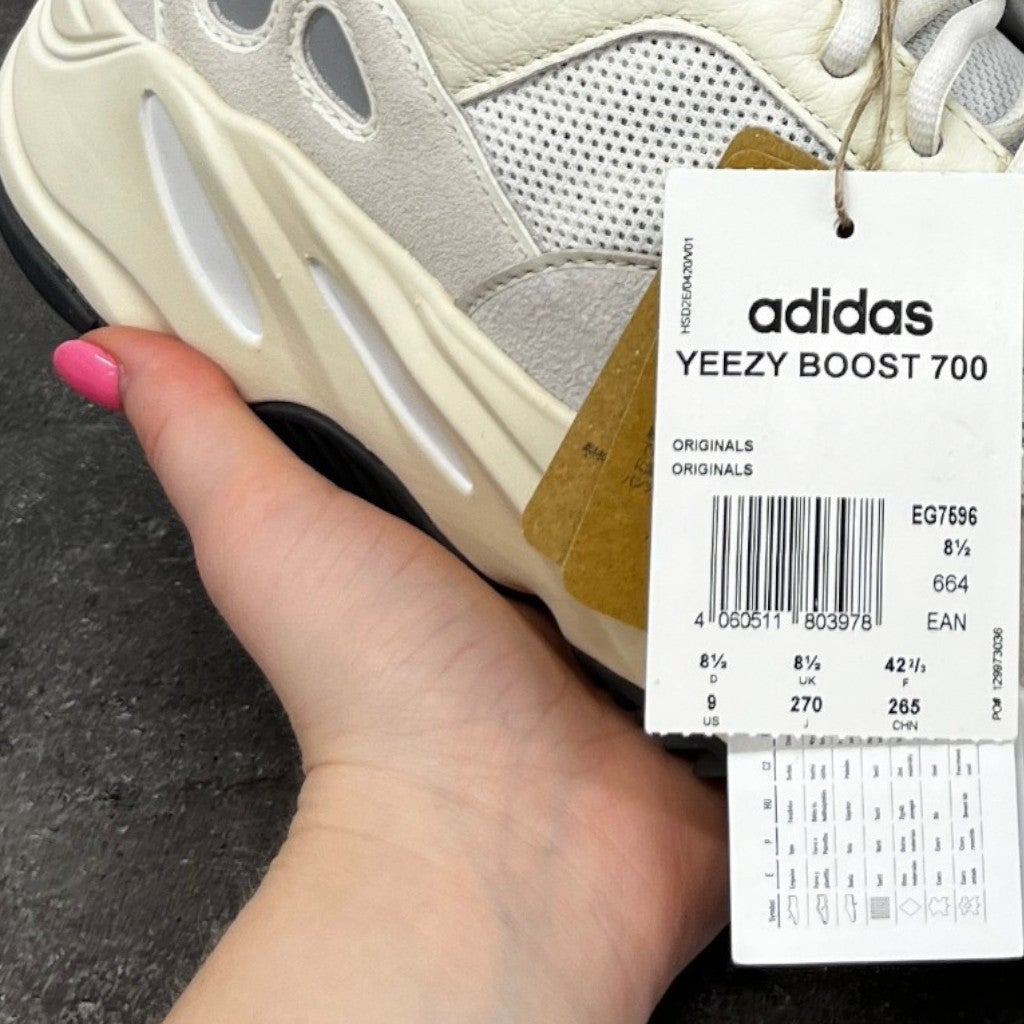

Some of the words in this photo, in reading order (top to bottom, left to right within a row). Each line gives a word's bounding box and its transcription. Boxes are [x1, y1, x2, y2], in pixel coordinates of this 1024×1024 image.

[748, 287, 934, 337] adidas
[676, 350, 788, 377] YEEZY
[799, 351, 921, 380] BOOST
[930, 354, 988, 381] 700
[672, 438, 754, 452] ORIGINALS
[672, 462, 754, 477] ORIGINALS
[912, 504, 978, 526] EG7596
[933, 574, 969, 593] 664
[693, 611, 705, 629] 4
[718, 611, 781, 629] 060511
[804, 612, 873, 632] 803978
[927, 611, 967, 632] EAN
[884, 656, 906, 673] 42
[709, 673, 718, 685] D
[799, 675, 816, 686] UK
[902, 677, 909, 688] F
[707, 694, 717, 711] 9
[790, 695, 823, 713] 270
[888, 697, 921, 715] 265
[702, 715, 720, 728] US
[892, 719, 919, 731] CHN
